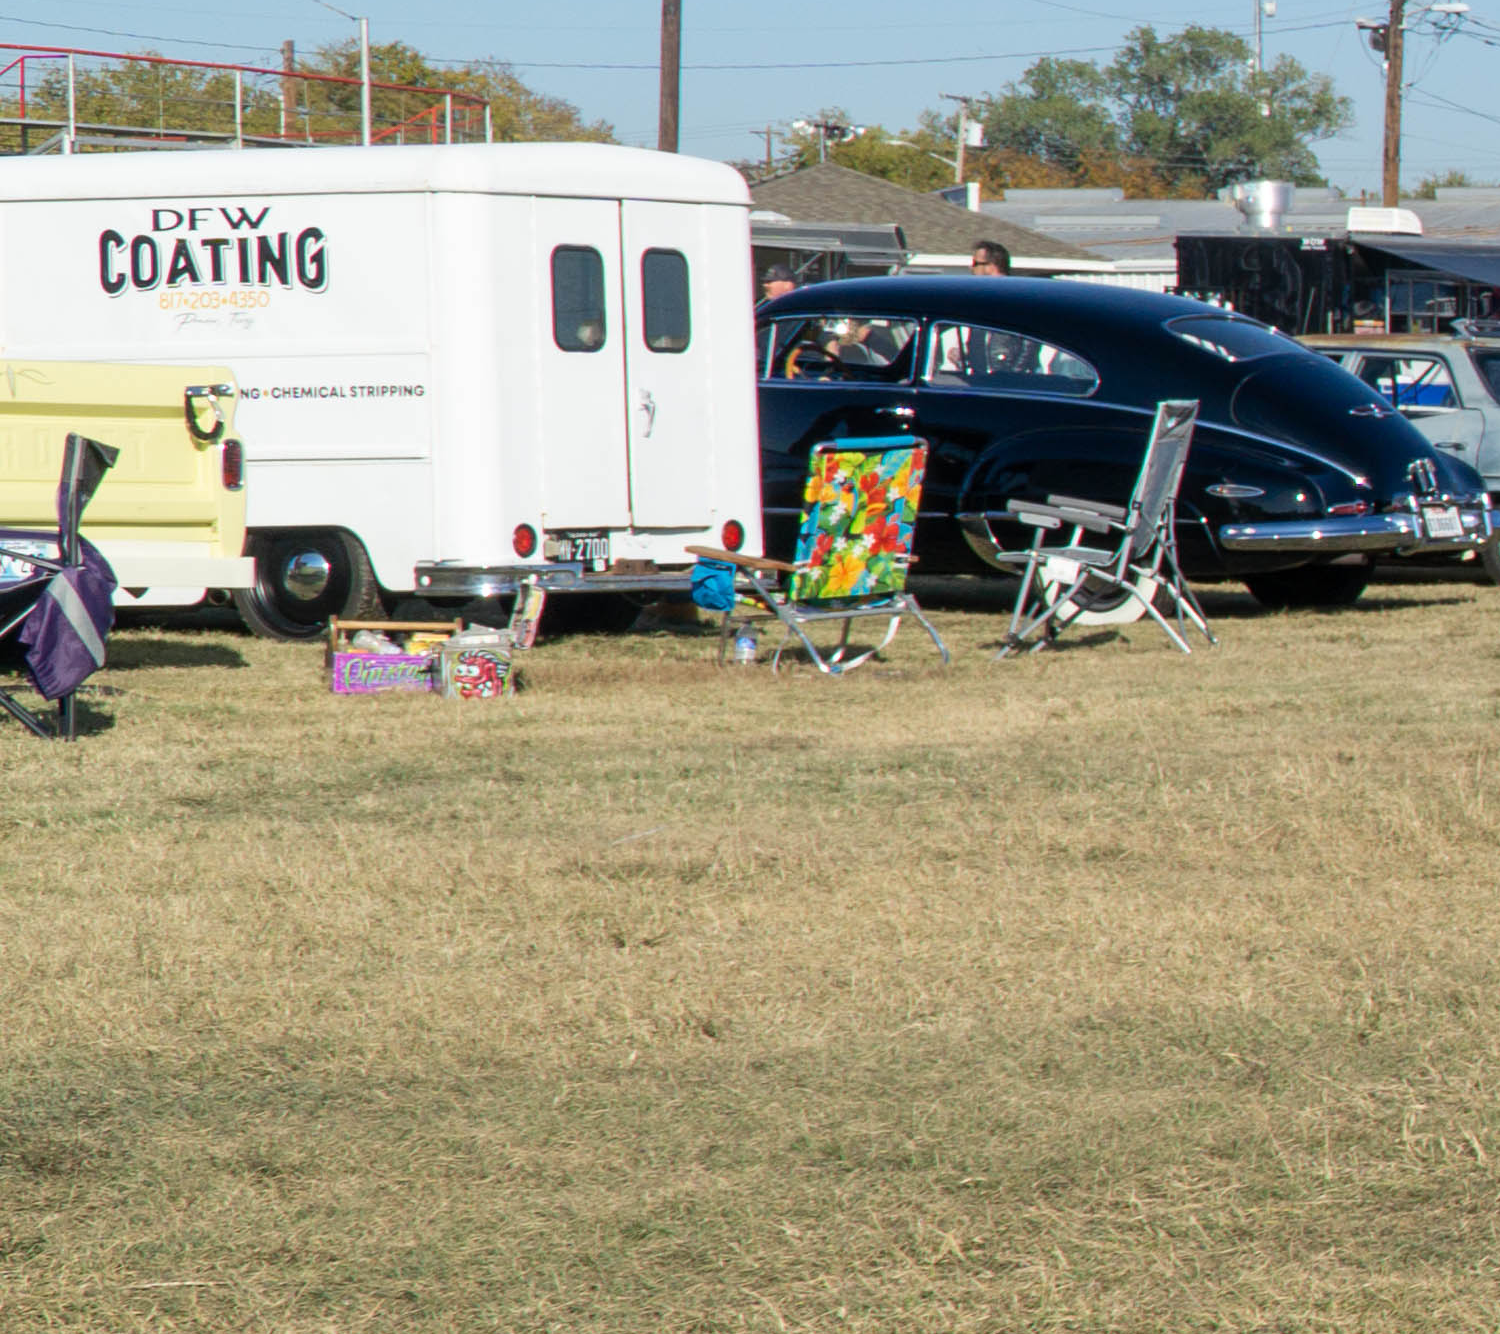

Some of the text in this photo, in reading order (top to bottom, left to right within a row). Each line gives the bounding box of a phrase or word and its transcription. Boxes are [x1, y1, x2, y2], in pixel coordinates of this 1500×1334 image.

[151, 206, 271, 232] DFW
[98, 226, 329, 298] COATING
[270, 386, 347, 400] CHEMICAL
[349, 385, 426, 399] STRIPPING
